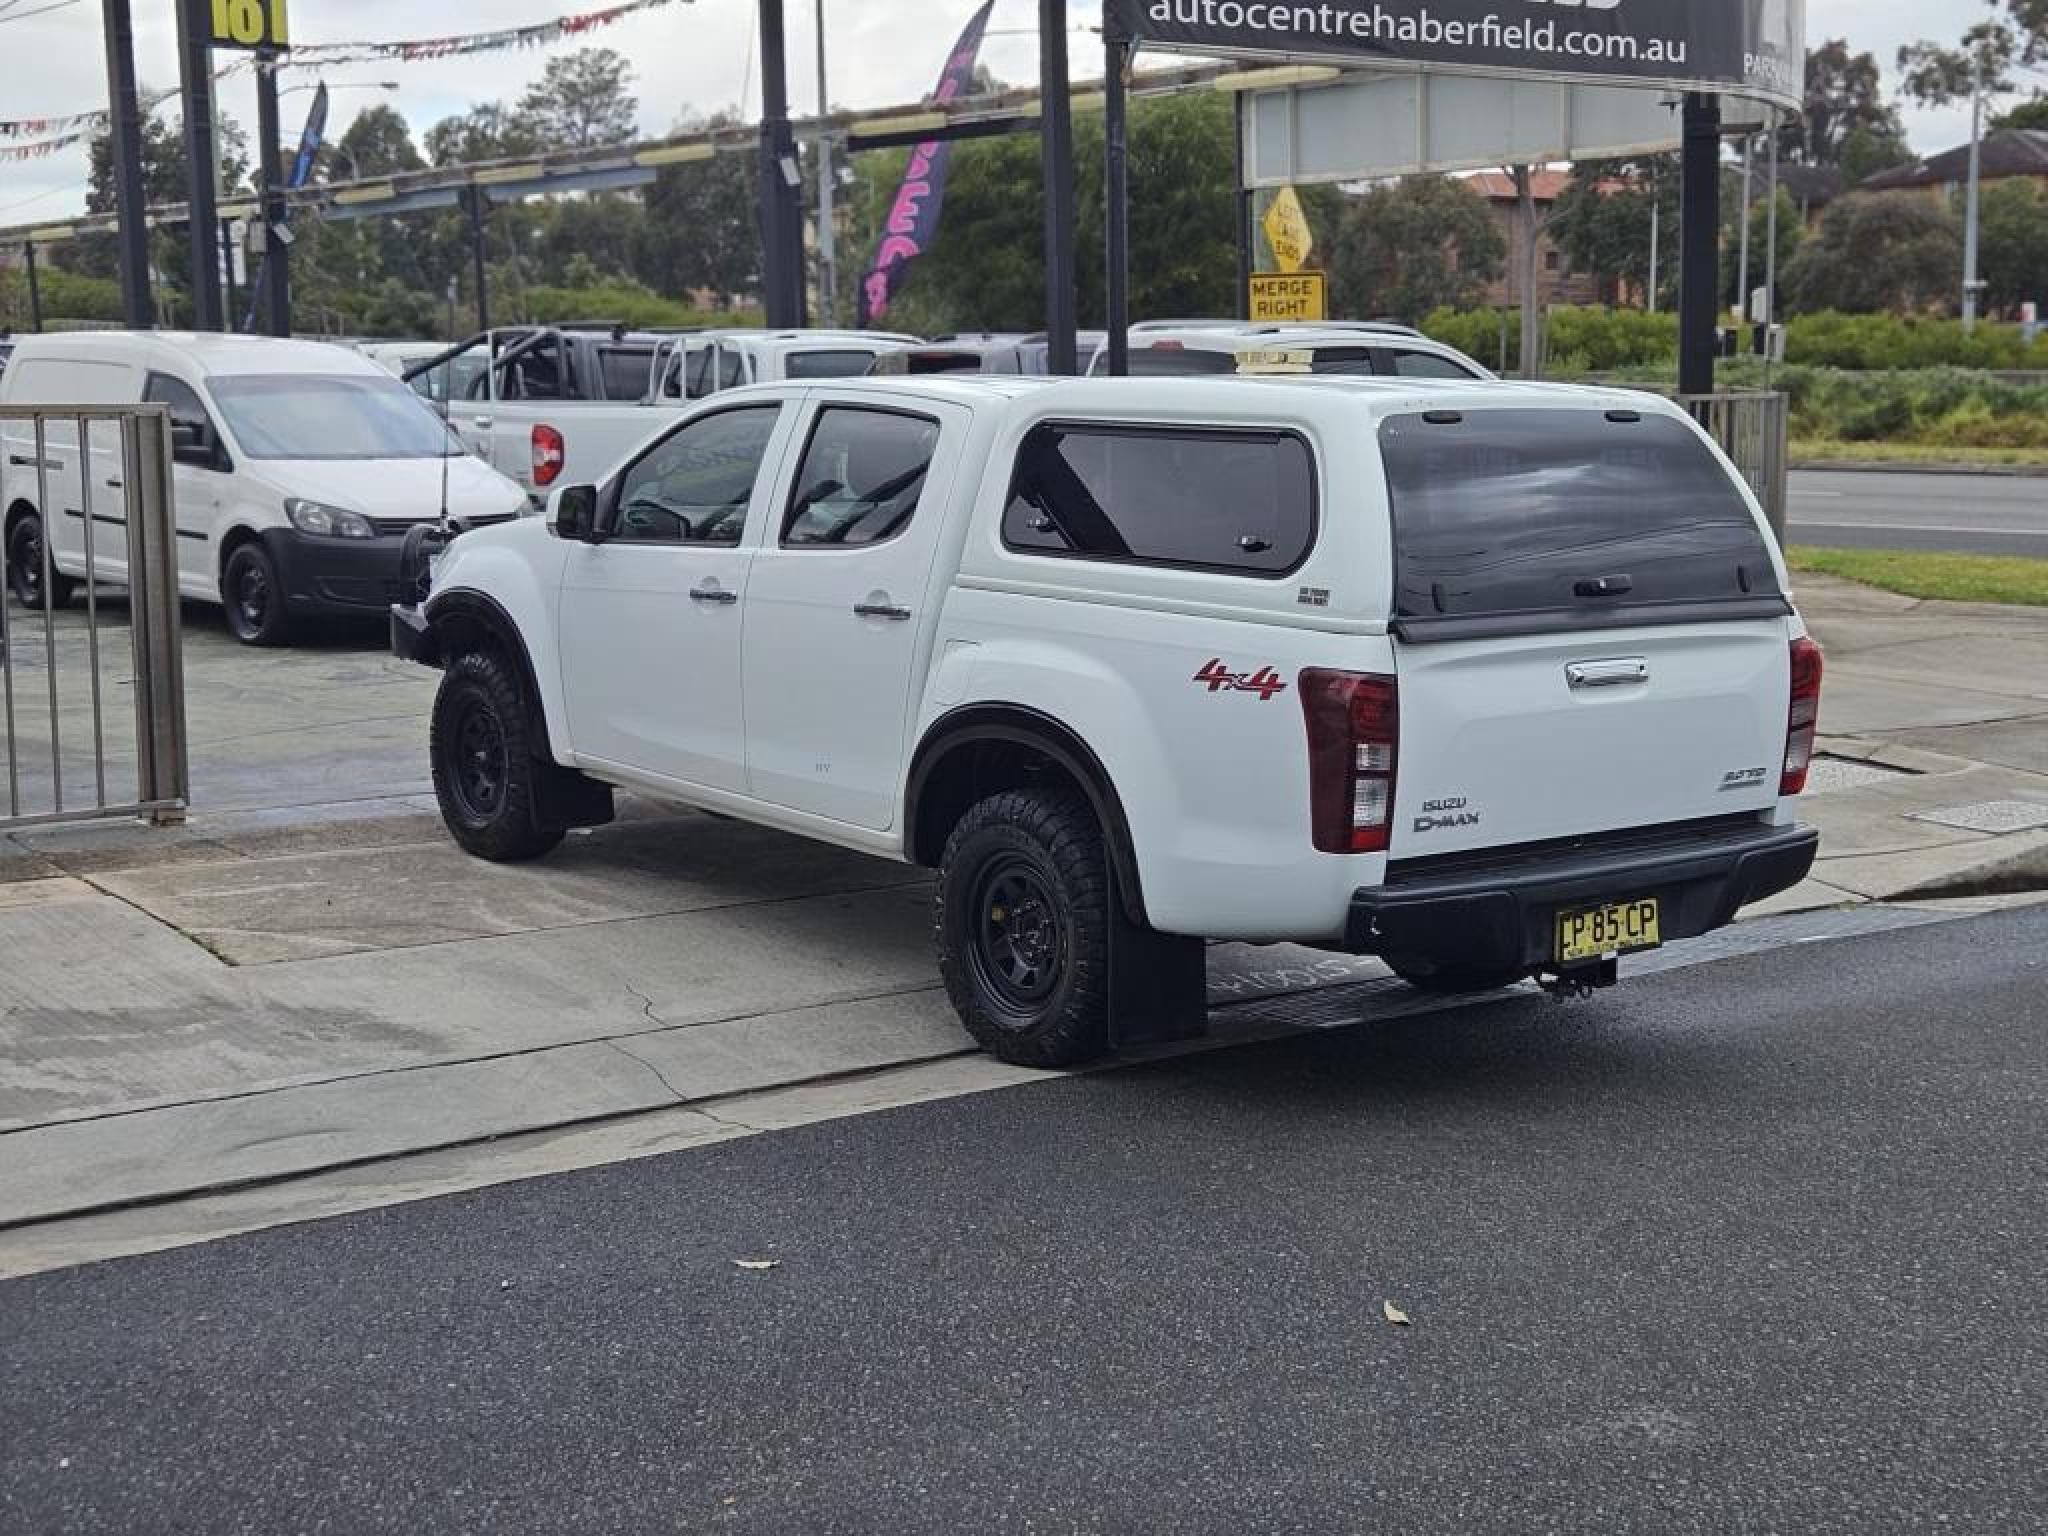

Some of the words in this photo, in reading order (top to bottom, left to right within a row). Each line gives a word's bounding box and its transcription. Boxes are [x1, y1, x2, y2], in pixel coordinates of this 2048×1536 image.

[1149, 0, 1686, 63] autocentrehaberfield.com.au
[1252, 280, 1313, 297] MERGE
[1257, 299, 1308, 315] RIGHT
[1193, 657, 1288, 700] 4x4
[1423, 796, 1467, 812] ISUZU
